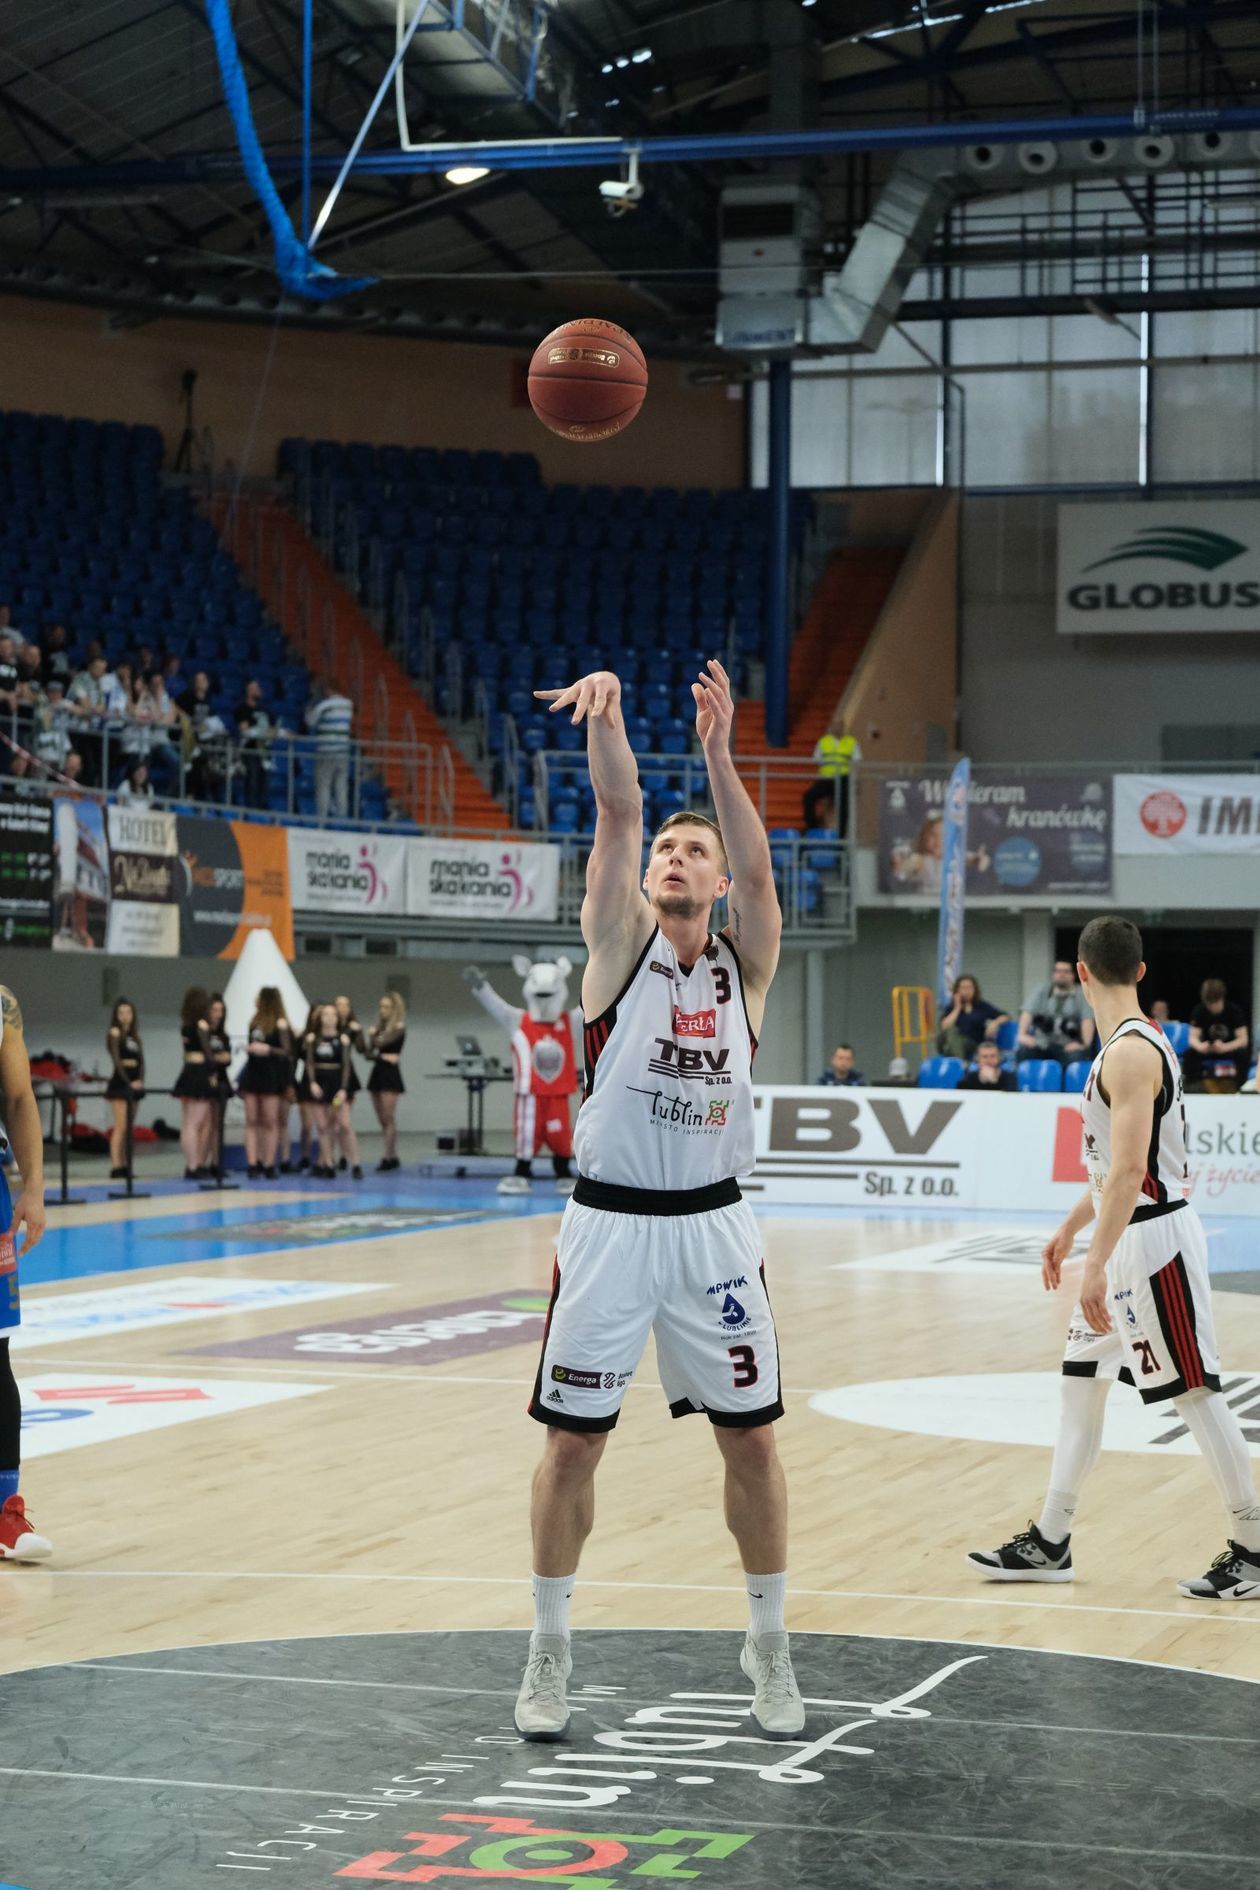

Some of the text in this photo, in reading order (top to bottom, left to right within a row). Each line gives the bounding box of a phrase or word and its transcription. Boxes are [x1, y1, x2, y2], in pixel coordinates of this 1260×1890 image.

[1067, 582, 1260, 611] GLOBUS
[119, 815, 168, 847] HOTEL
[1197, 796, 1260, 835] IM
[430, 857, 490, 877] mania
[710, 966, 732, 1005] 3
[655, 1037, 730, 1072] TBV
[754, 1097, 964, 1155] BV
[864, 1172, 959, 1196] Sp. z o.o.
[728, 1344, 759, 1389] 3
[1131, 1339, 1162, 1375] 21
[568, 1373, 597, 1386] Energa
[215, 1753, 490, 1871] INSPIRACJI
